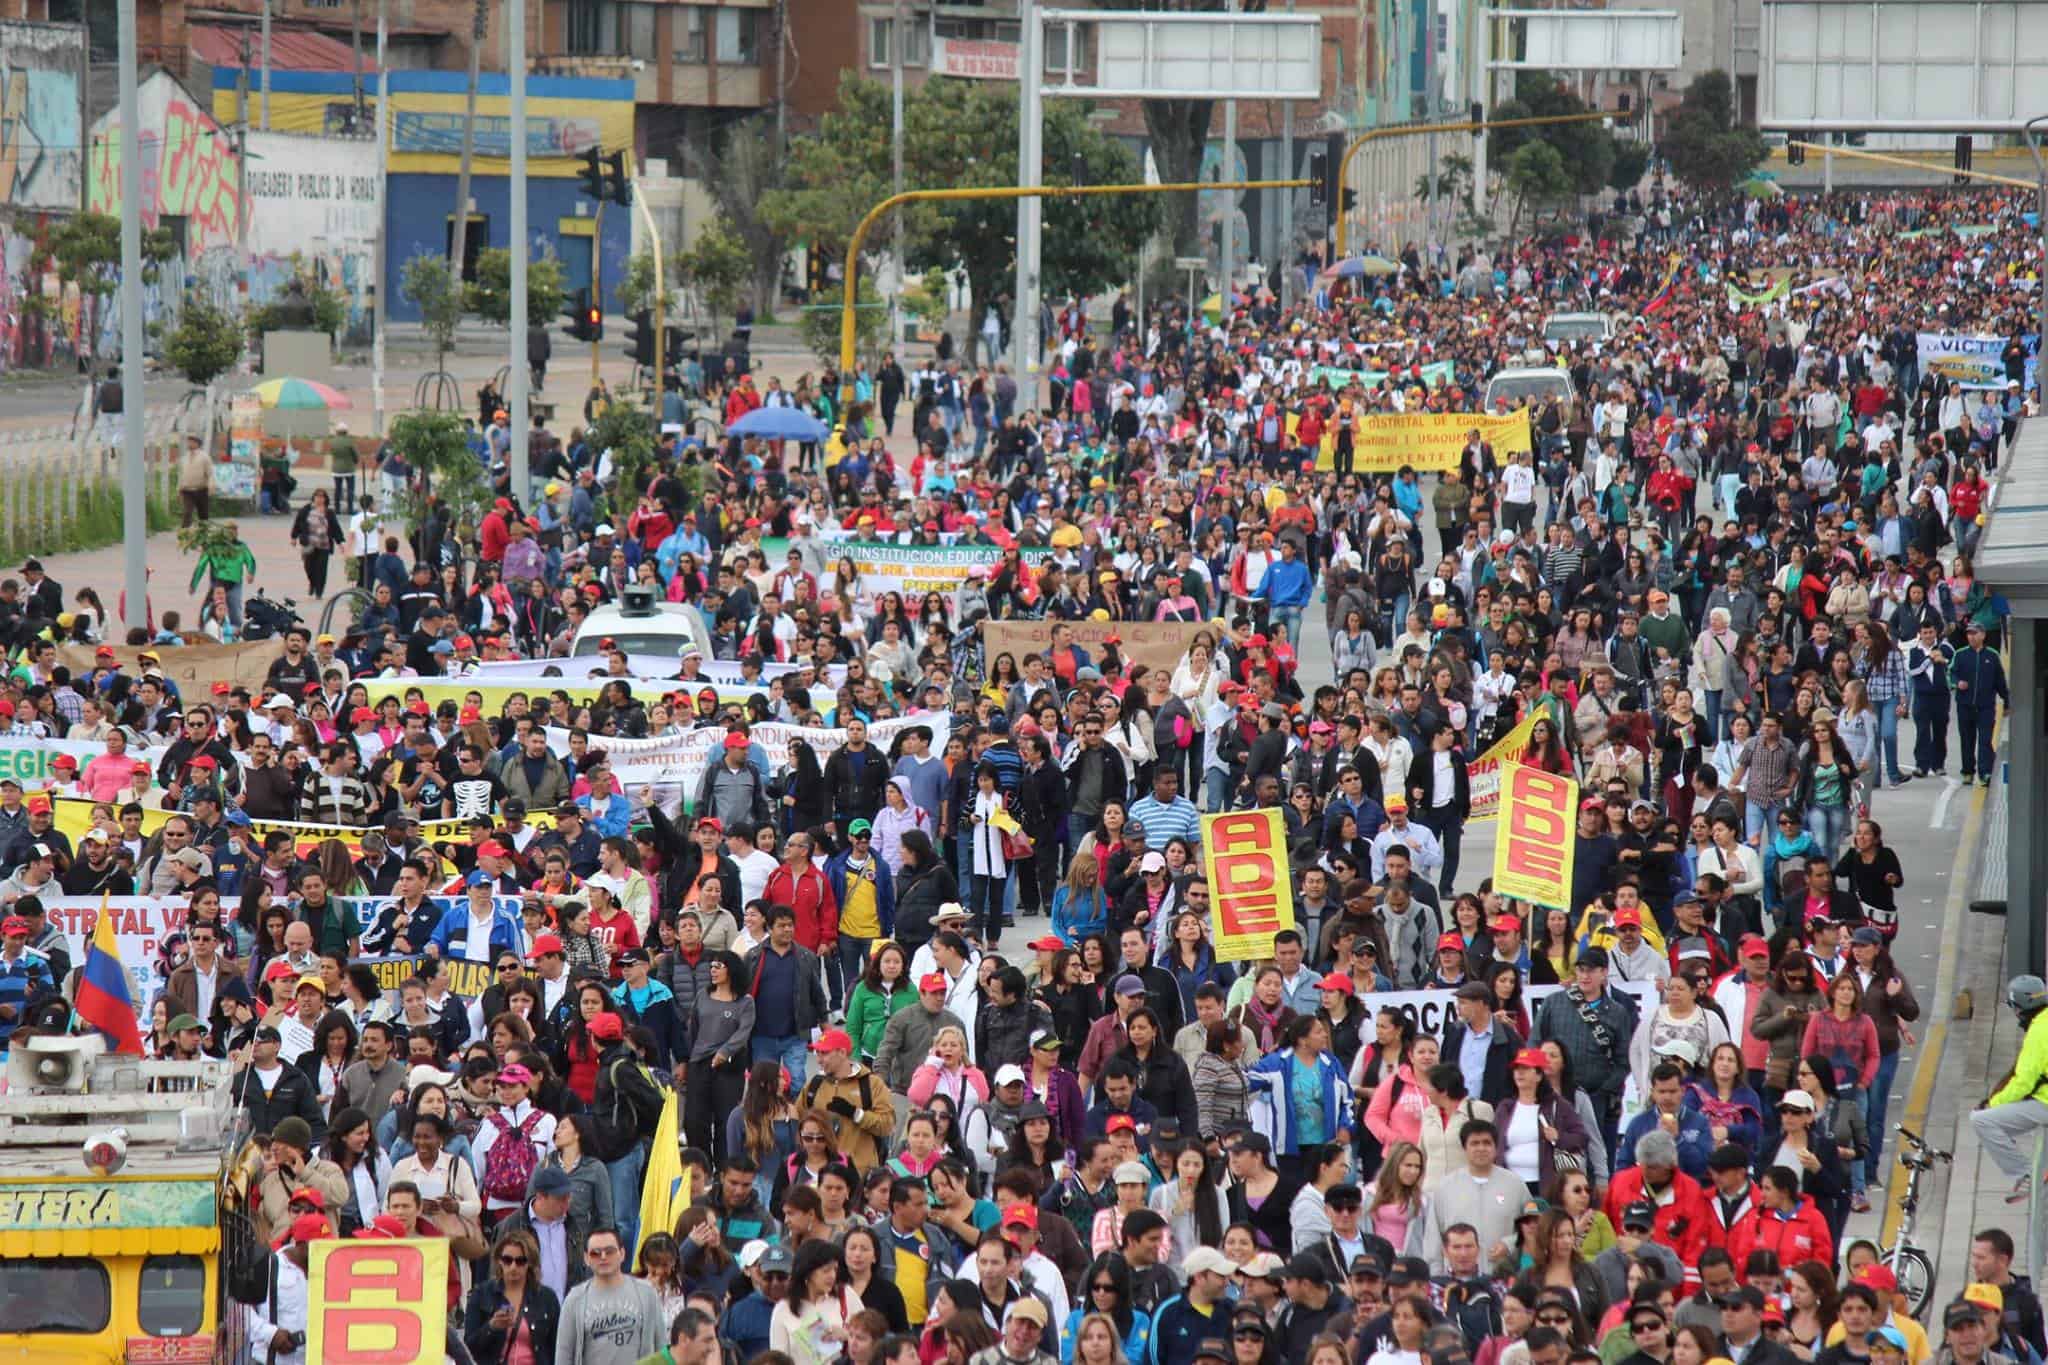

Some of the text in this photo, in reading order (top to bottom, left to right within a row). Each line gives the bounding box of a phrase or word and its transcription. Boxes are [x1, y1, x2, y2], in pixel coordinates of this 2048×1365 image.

[858, 547, 944, 564] INSTITUCION
[1212, 813, 1280, 936] ADE
[1507, 767, 1570, 885] ADE
